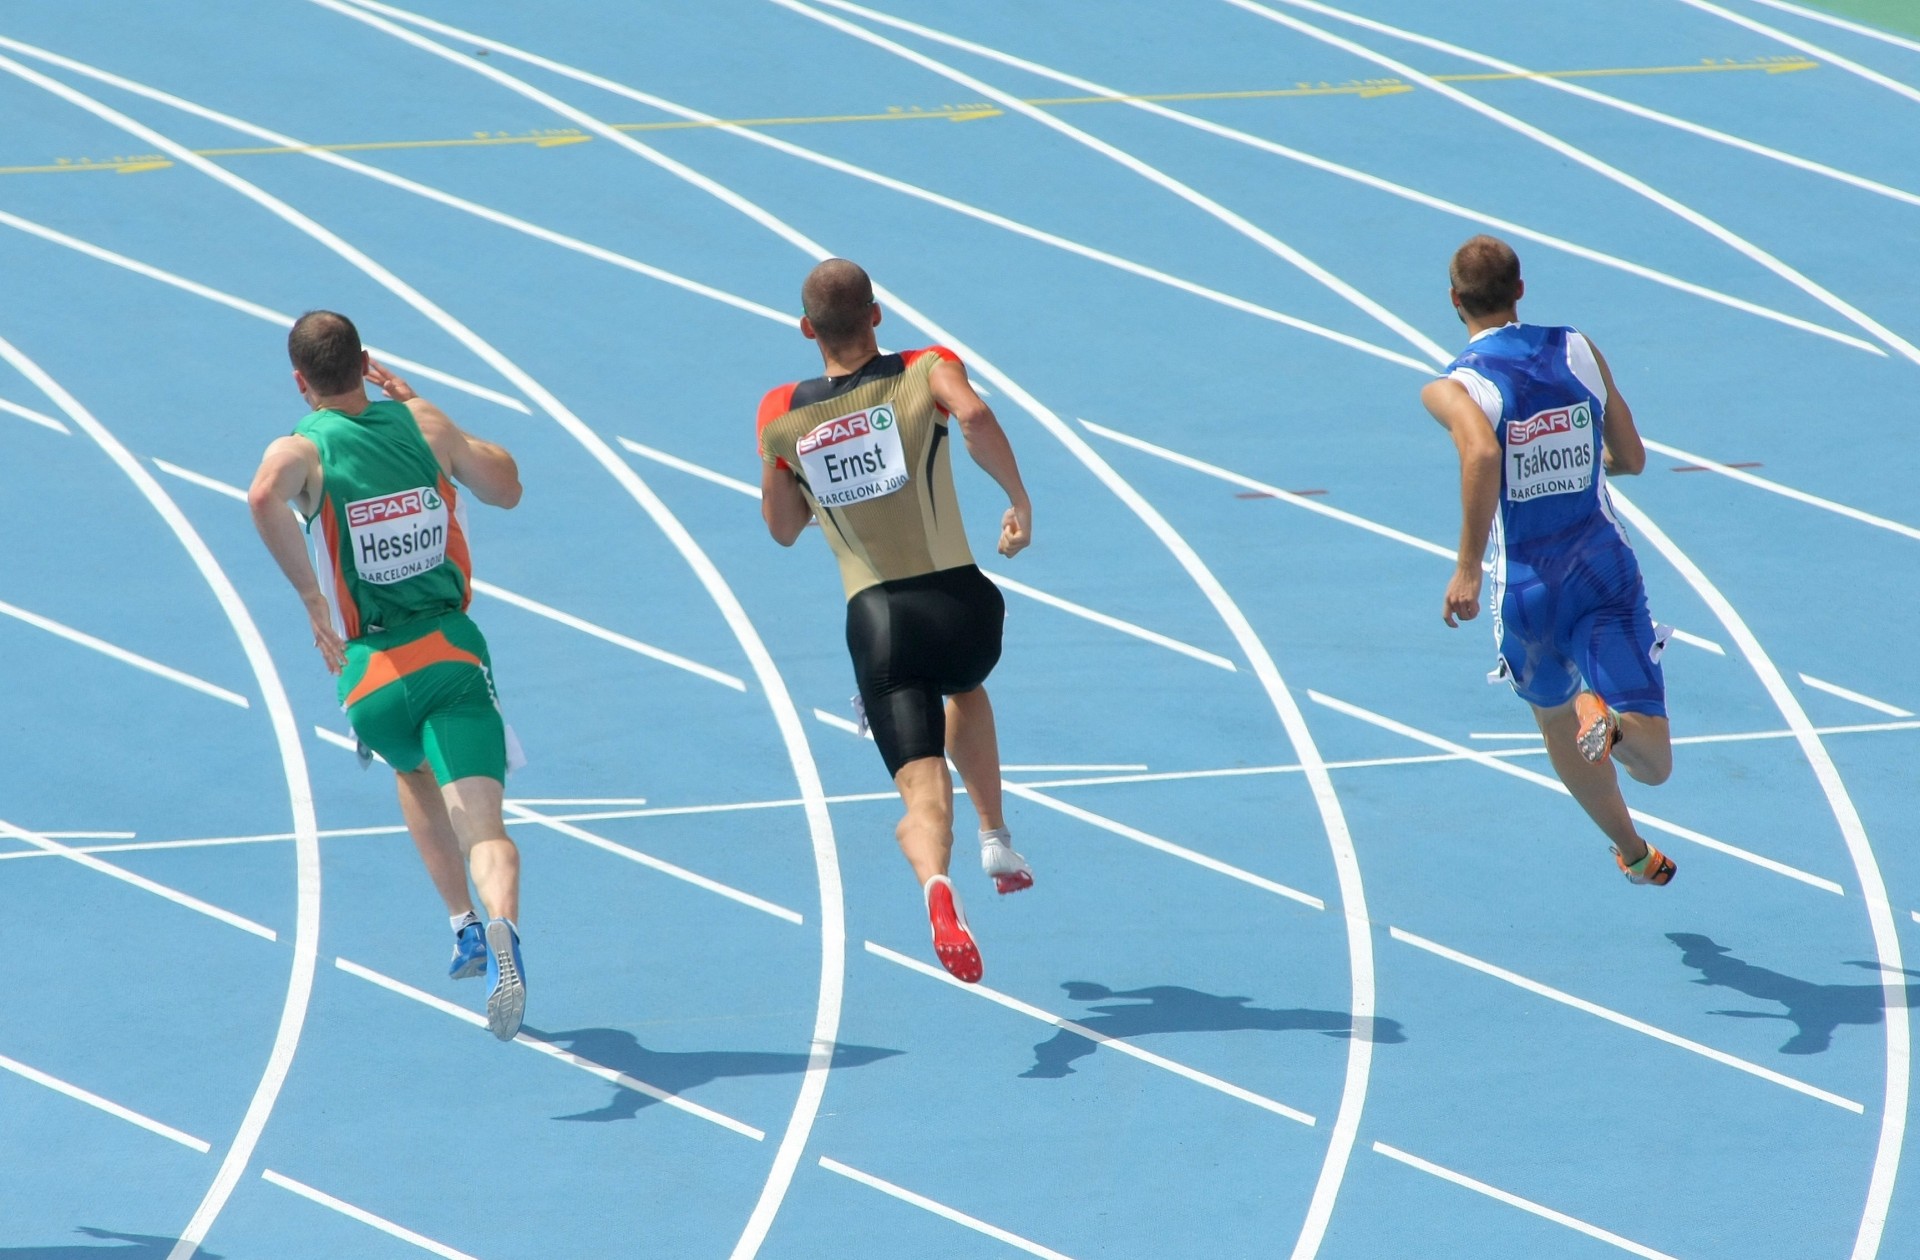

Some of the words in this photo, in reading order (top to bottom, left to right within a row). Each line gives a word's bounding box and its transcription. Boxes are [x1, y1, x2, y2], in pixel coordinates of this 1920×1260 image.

[800, 416, 868, 451] SPAR
[1510, 413, 1568, 442] SPAR
[824, 443, 886, 484] Ernst
[1513, 443, 1590, 480] Tsákonas
[818, 483, 883, 505] BARCELONA
[1511, 479, 1575, 499] BARCELONA
[351, 495, 419, 524] SPAR
[360, 523, 442, 563] Hession
